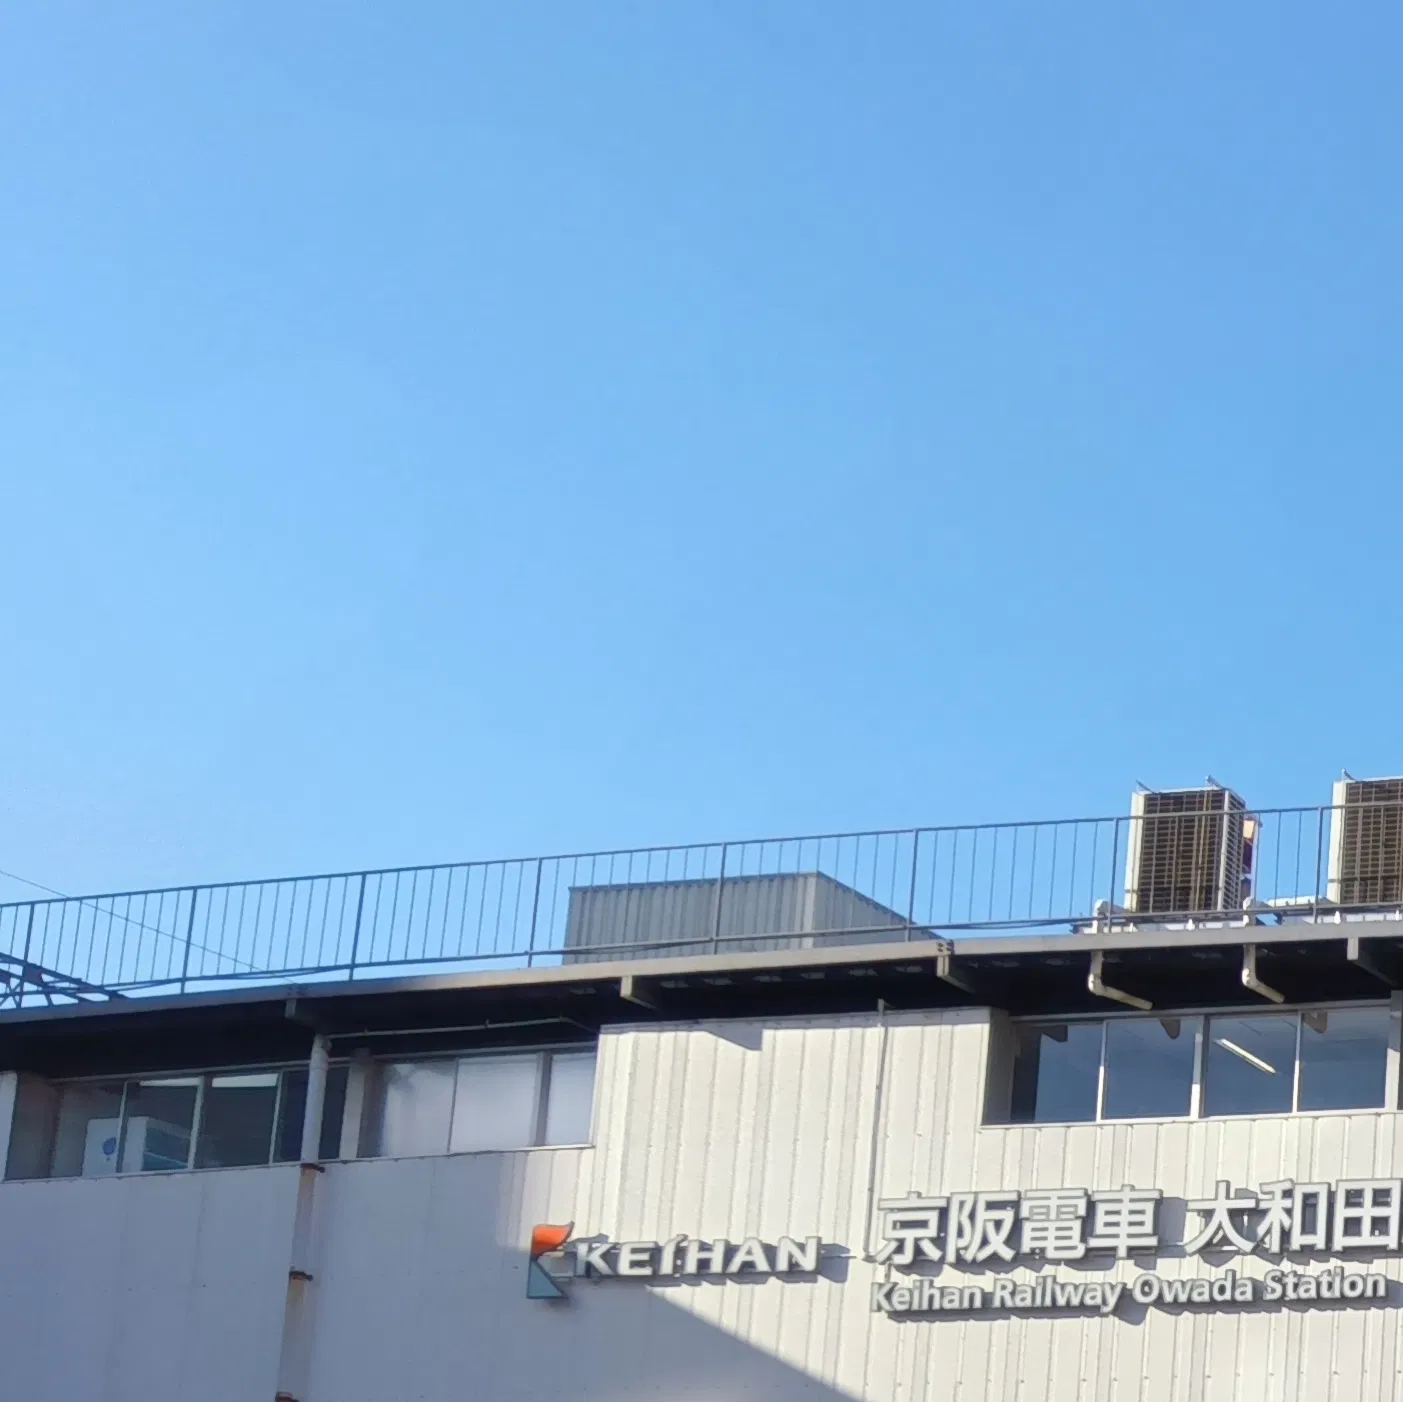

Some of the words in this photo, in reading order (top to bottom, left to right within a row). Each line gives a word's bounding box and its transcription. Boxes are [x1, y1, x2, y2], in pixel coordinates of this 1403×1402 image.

[875, 1184, 1162, 1265] 京阪電車
[575, 1234, 820, 1278] KEIHAN
[871, 1278, 982, 1312] Keihan
[993, 1275, 1123, 1314] Railway
[1133, 1269, 1253, 1304] Owada
[1263, 1266, 1387, 1301] Station
